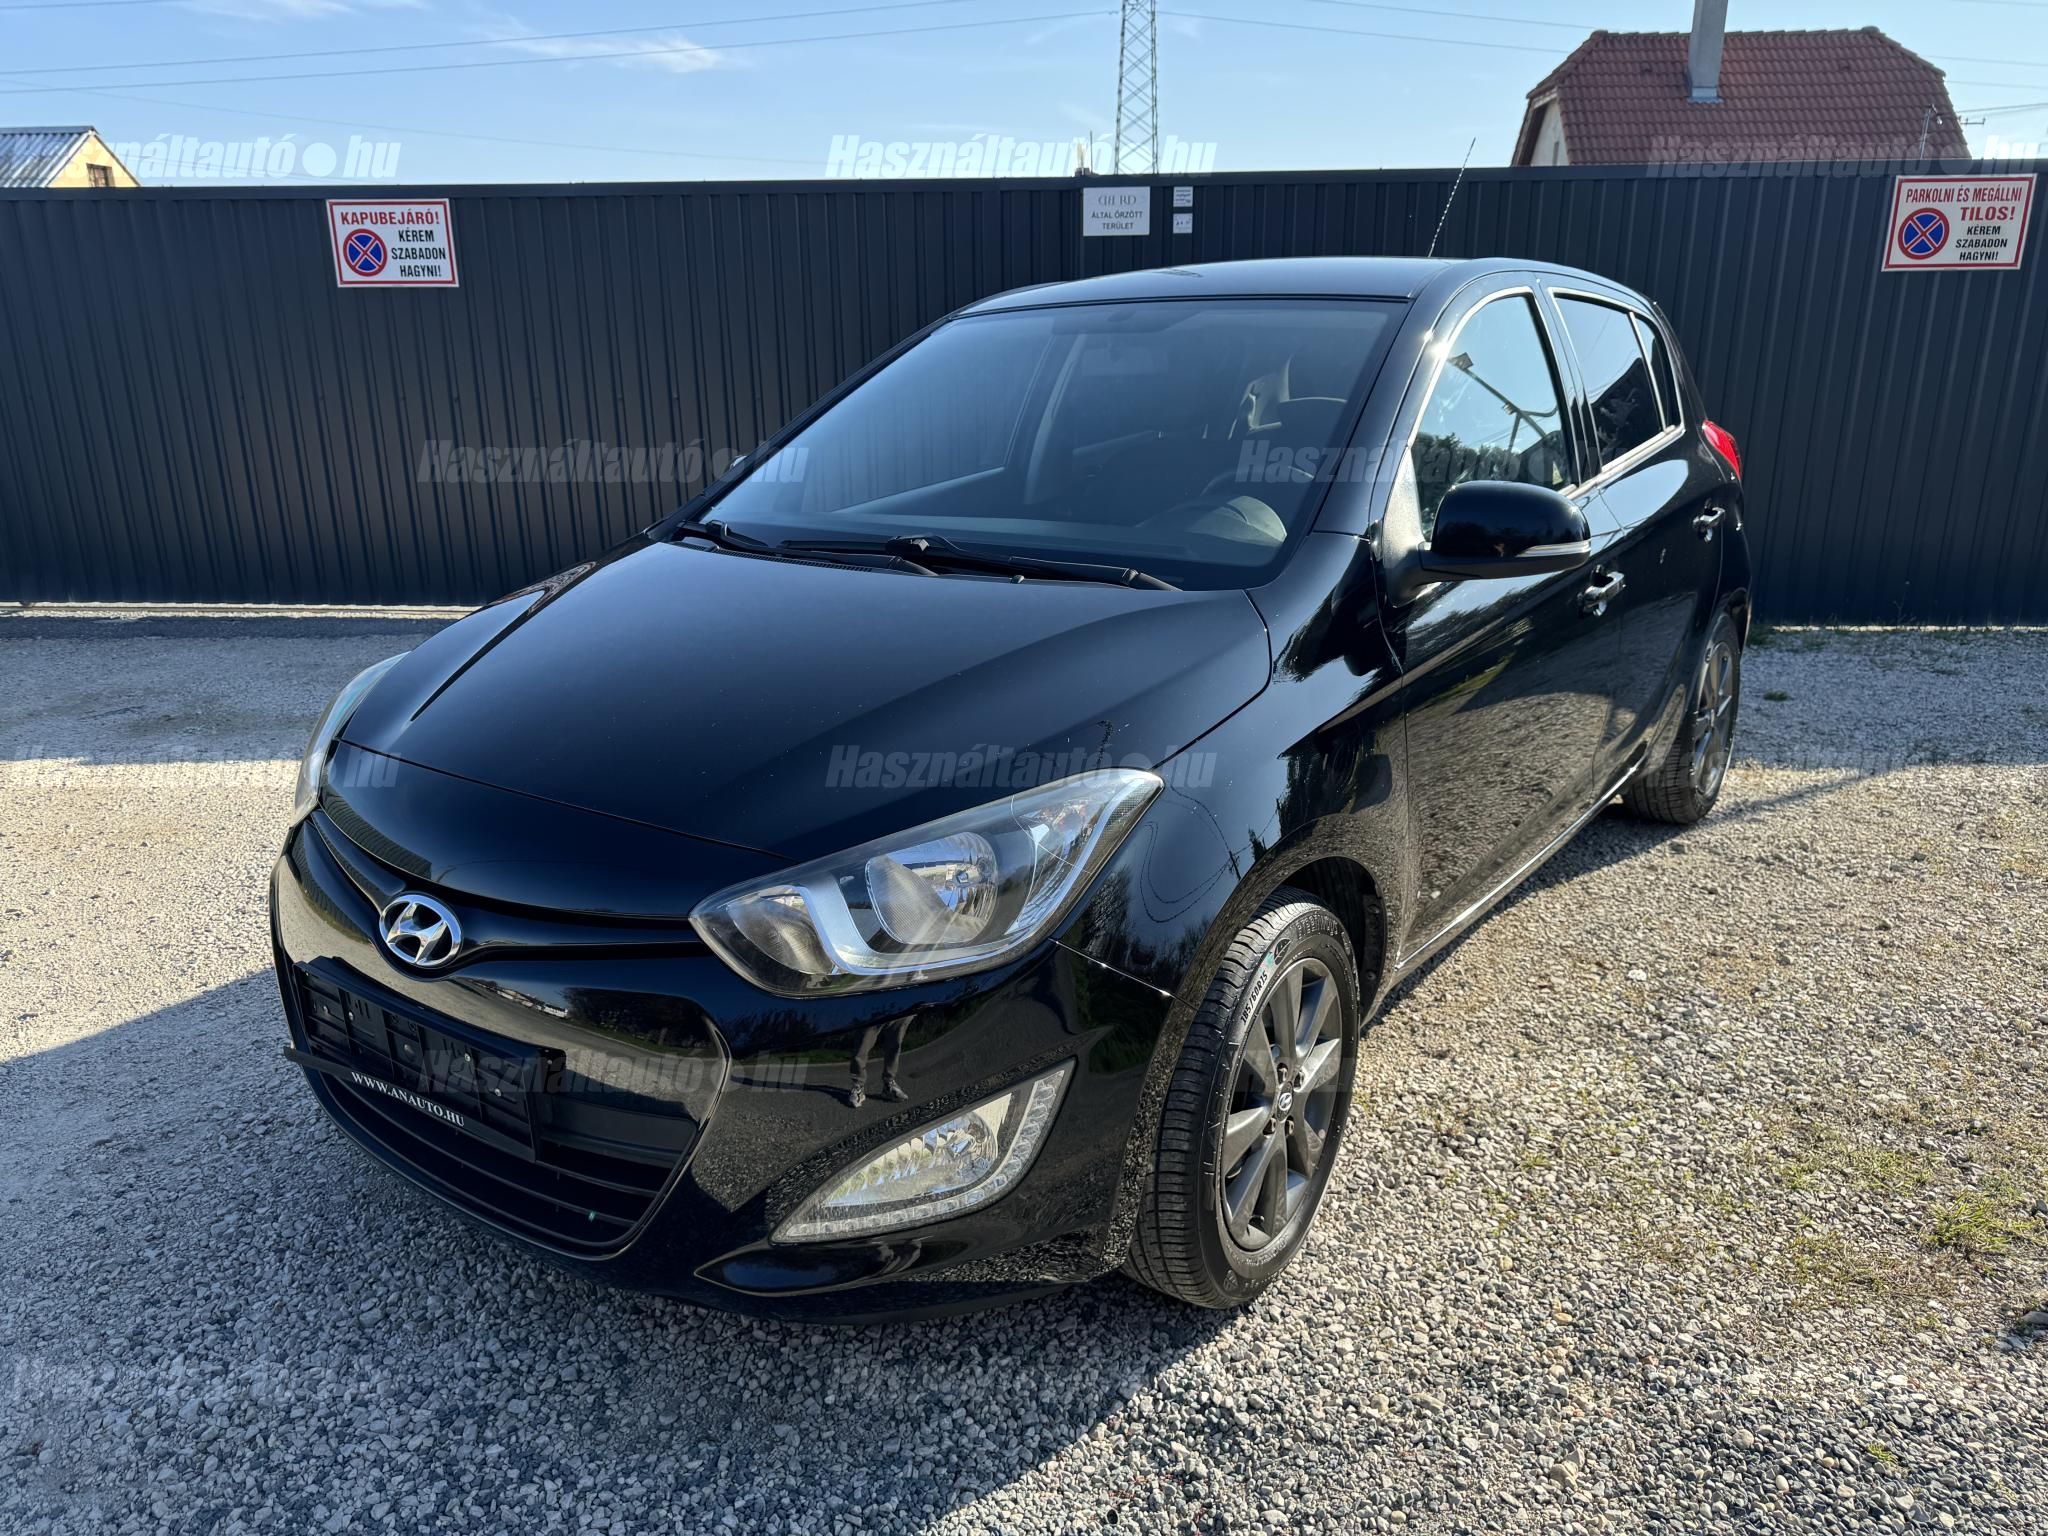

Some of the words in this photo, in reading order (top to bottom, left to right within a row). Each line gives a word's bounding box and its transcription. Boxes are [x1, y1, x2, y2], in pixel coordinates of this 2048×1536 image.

[1906, 187, 1955, 203] PARKOLNI
[1956, 184, 1970, 203] ÉS
[1971, 183, 2022, 203] MEGÁLLNI
[340, 208, 440, 225] KAPUBEJÁRÓ!
[1091, 210, 1112, 219] ÁLTAL
[1960, 206, 2015, 221] TILOS!
[1102, 221, 1134, 230] TERÜLET
[1966, 223, 2001, 236] KÉREM
[398, 227, 435, 242] KÉREM
[1955, 238, 2008, 249] SZABADON
[391, 247, 446, 260] SZABADON
[1959, 251, 1999, 261] HAGYNI!
[400, 265, 442, 277] HAGYNI!
[1240, 970, 1268, 1025] 185/60R15
[351, 1071, 465, 1127] WWW.ANAUTO.HU
